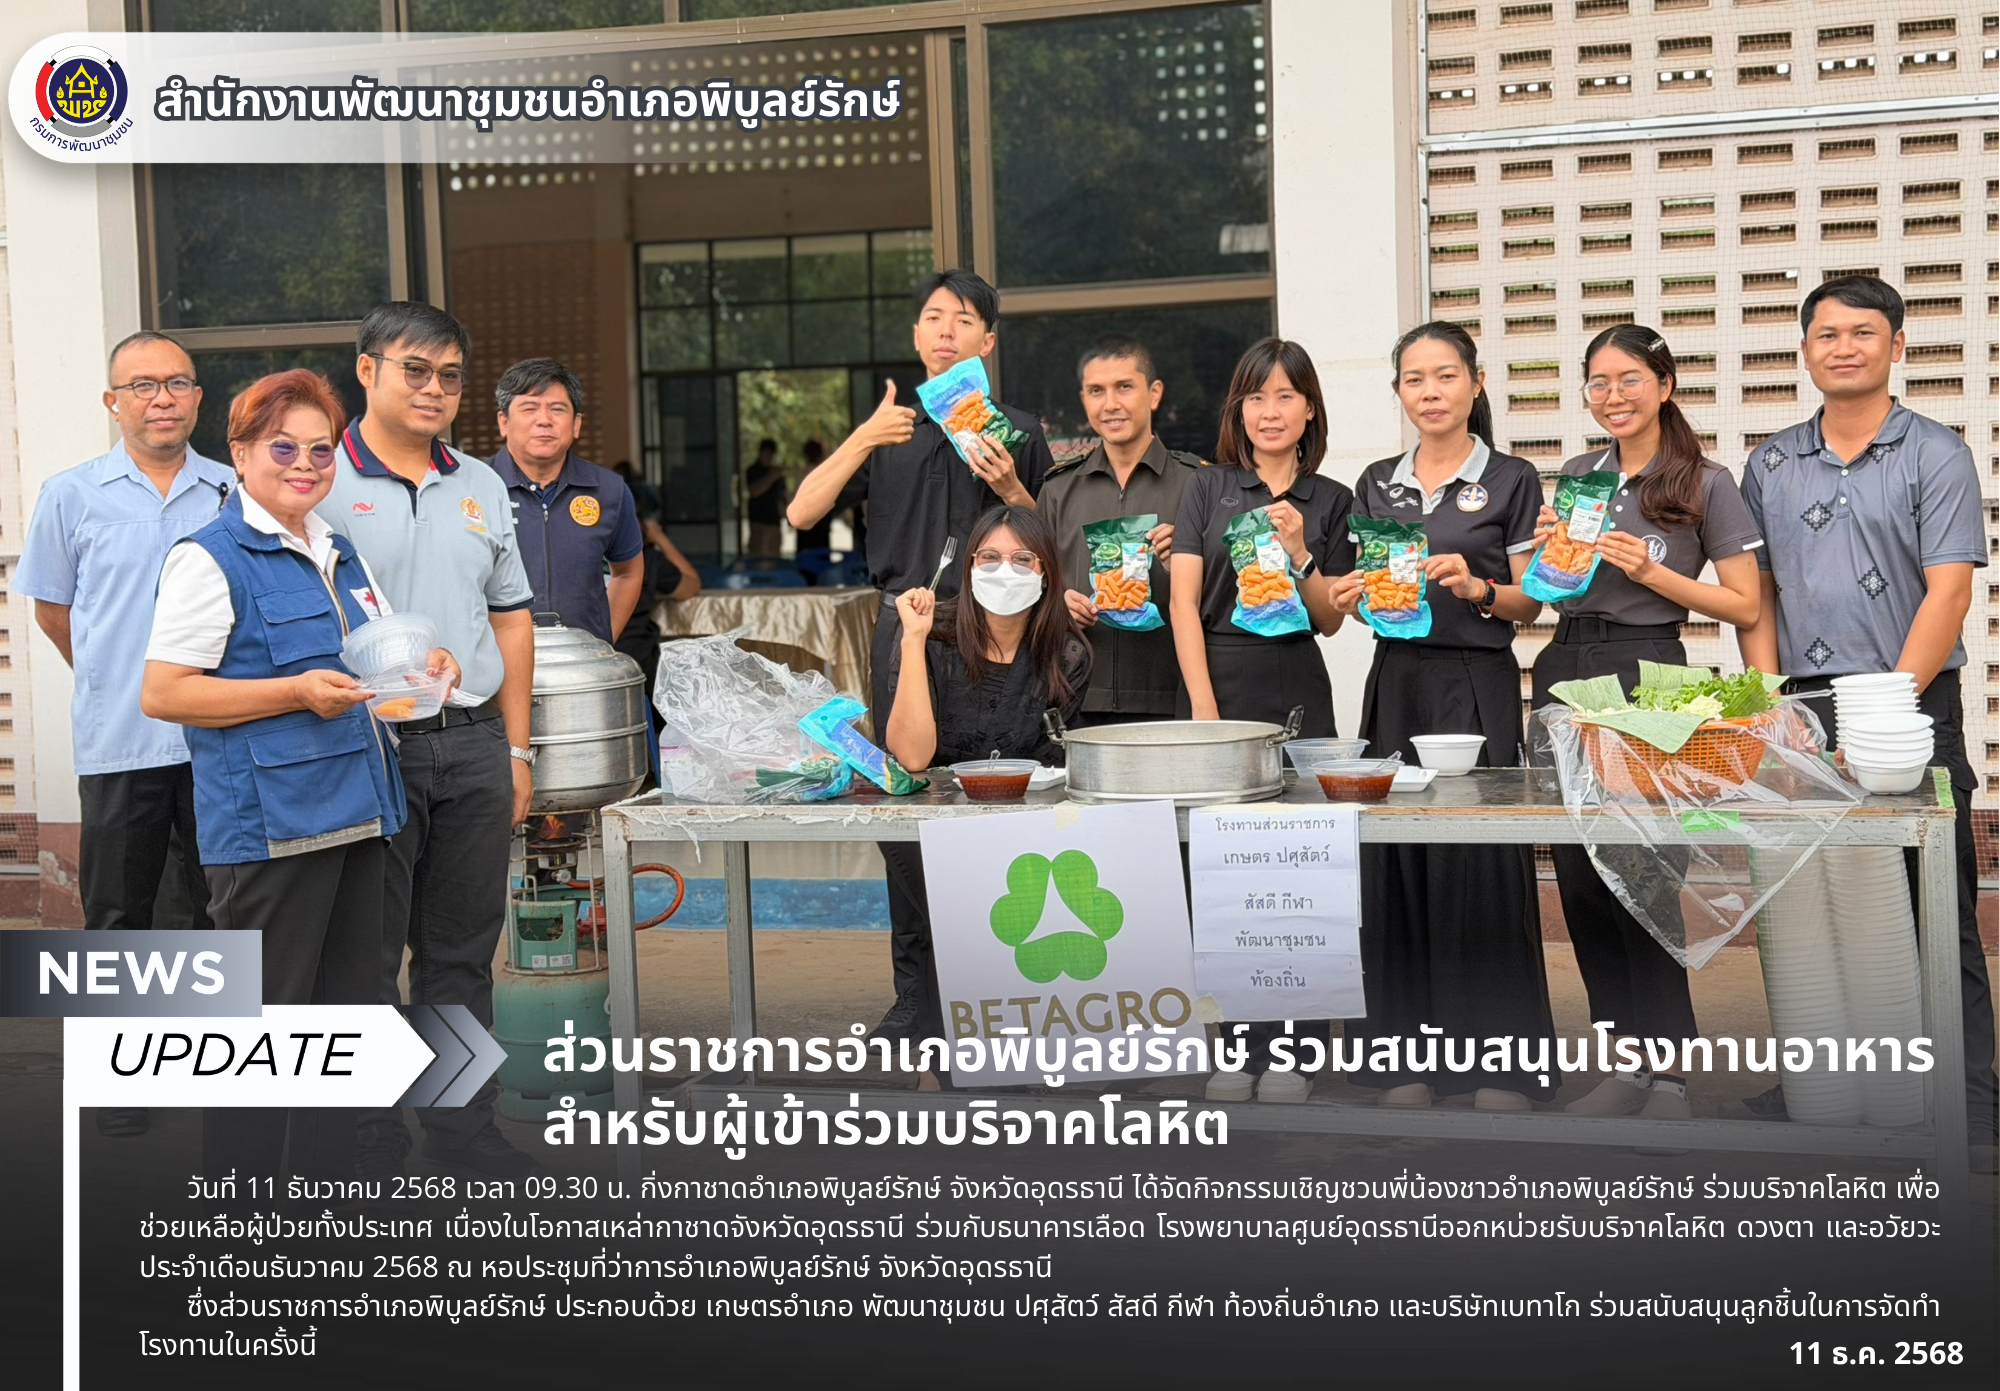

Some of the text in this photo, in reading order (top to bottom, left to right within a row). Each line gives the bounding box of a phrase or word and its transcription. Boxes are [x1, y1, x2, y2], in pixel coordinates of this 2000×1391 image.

[1215, 817, 1336, 831] โรงทานส่วนราชการ
[1224, 844, 1331, 868] เกษตร ปศุสัตว์
[1244, 893, 1313, 910] สัสดี กีฬา
[1235, 930, 1327, 952] พัฒนาชุมชน
[1250, 966, 1307, 987] ท้องถิ่น
[950, 987, 1192, 1040] BETAGRO
